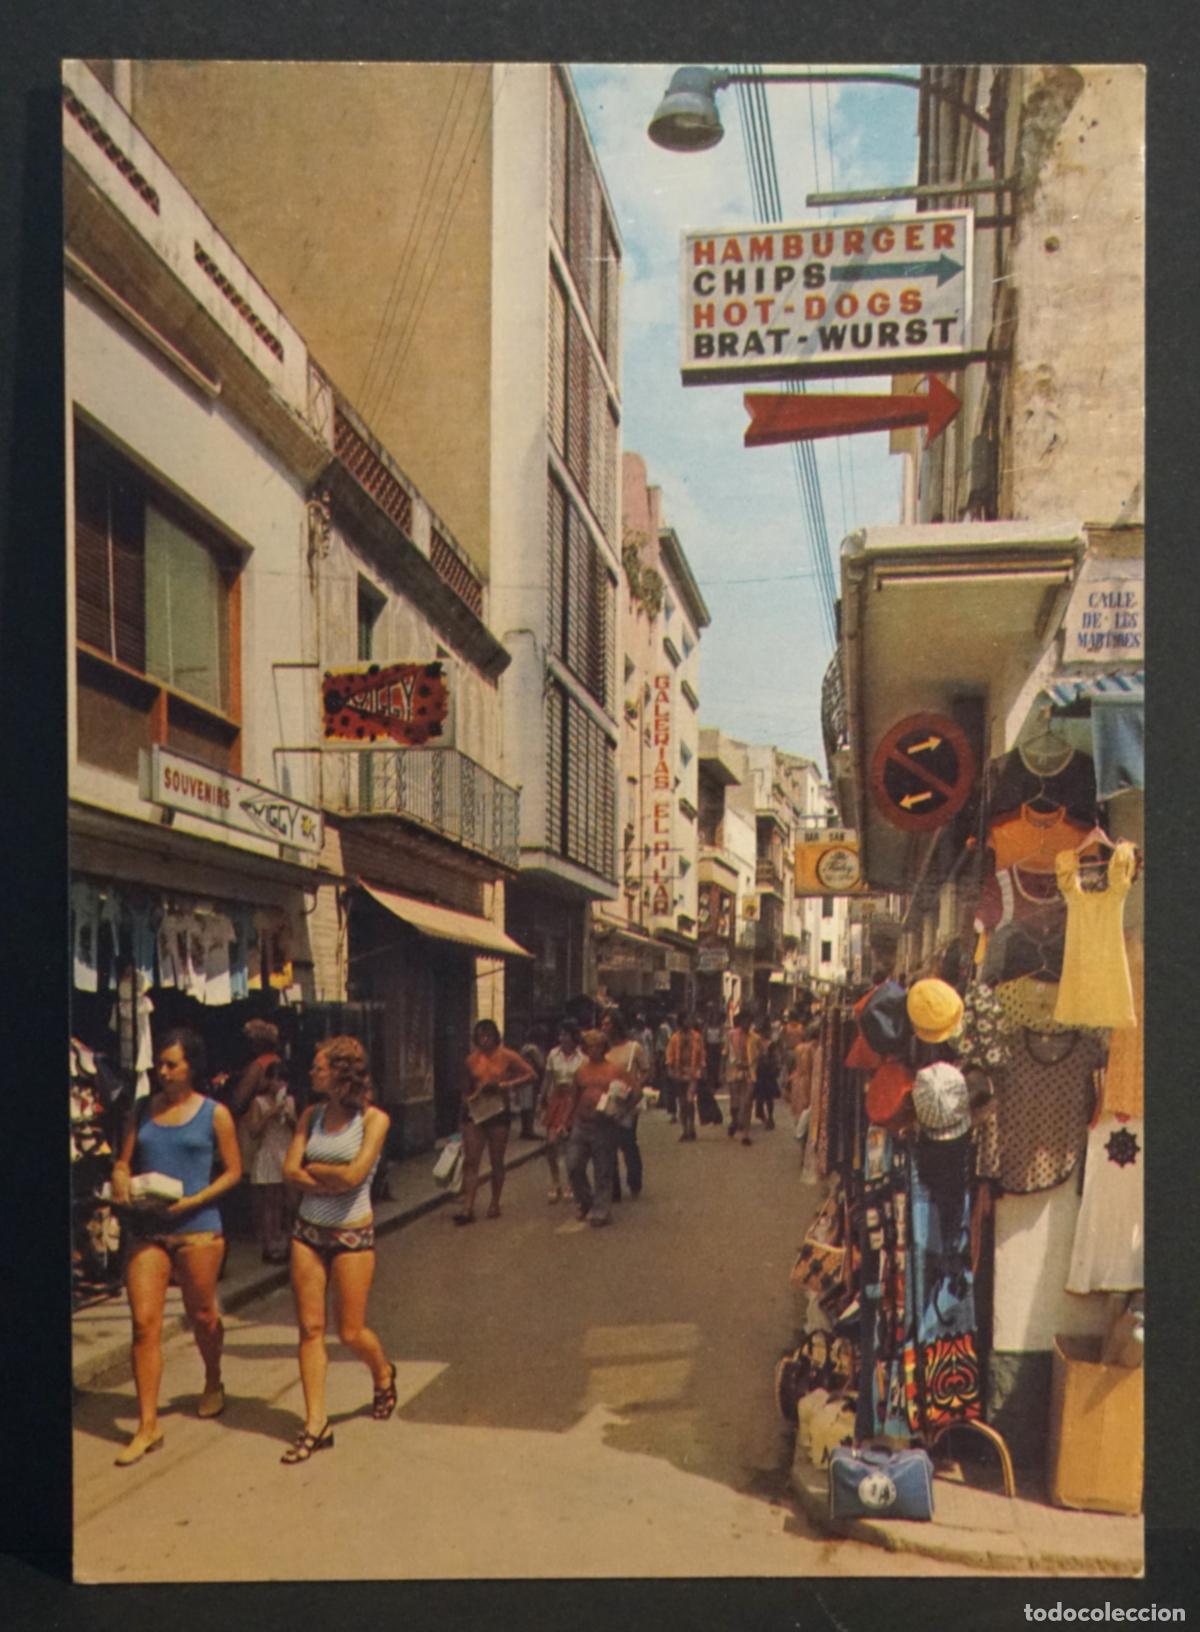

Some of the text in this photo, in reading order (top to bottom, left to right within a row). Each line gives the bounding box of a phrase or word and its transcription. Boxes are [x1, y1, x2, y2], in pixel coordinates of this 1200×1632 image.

[693, 223, 956, 266] HAMBURGER
[693, 262, 826, 296] CHIPS
[693, 288, 923, 329] HOT-DOGS
[693, 316, 957, 359] BRAT-WURST
[1082, 611, 1102, 629] DE
[1088, 591, 1138, 608] CALLE
[163, 767, 231, 809] SOUVENIRS
[653, 675, 671, 917] GALERIAS EL PILAR
